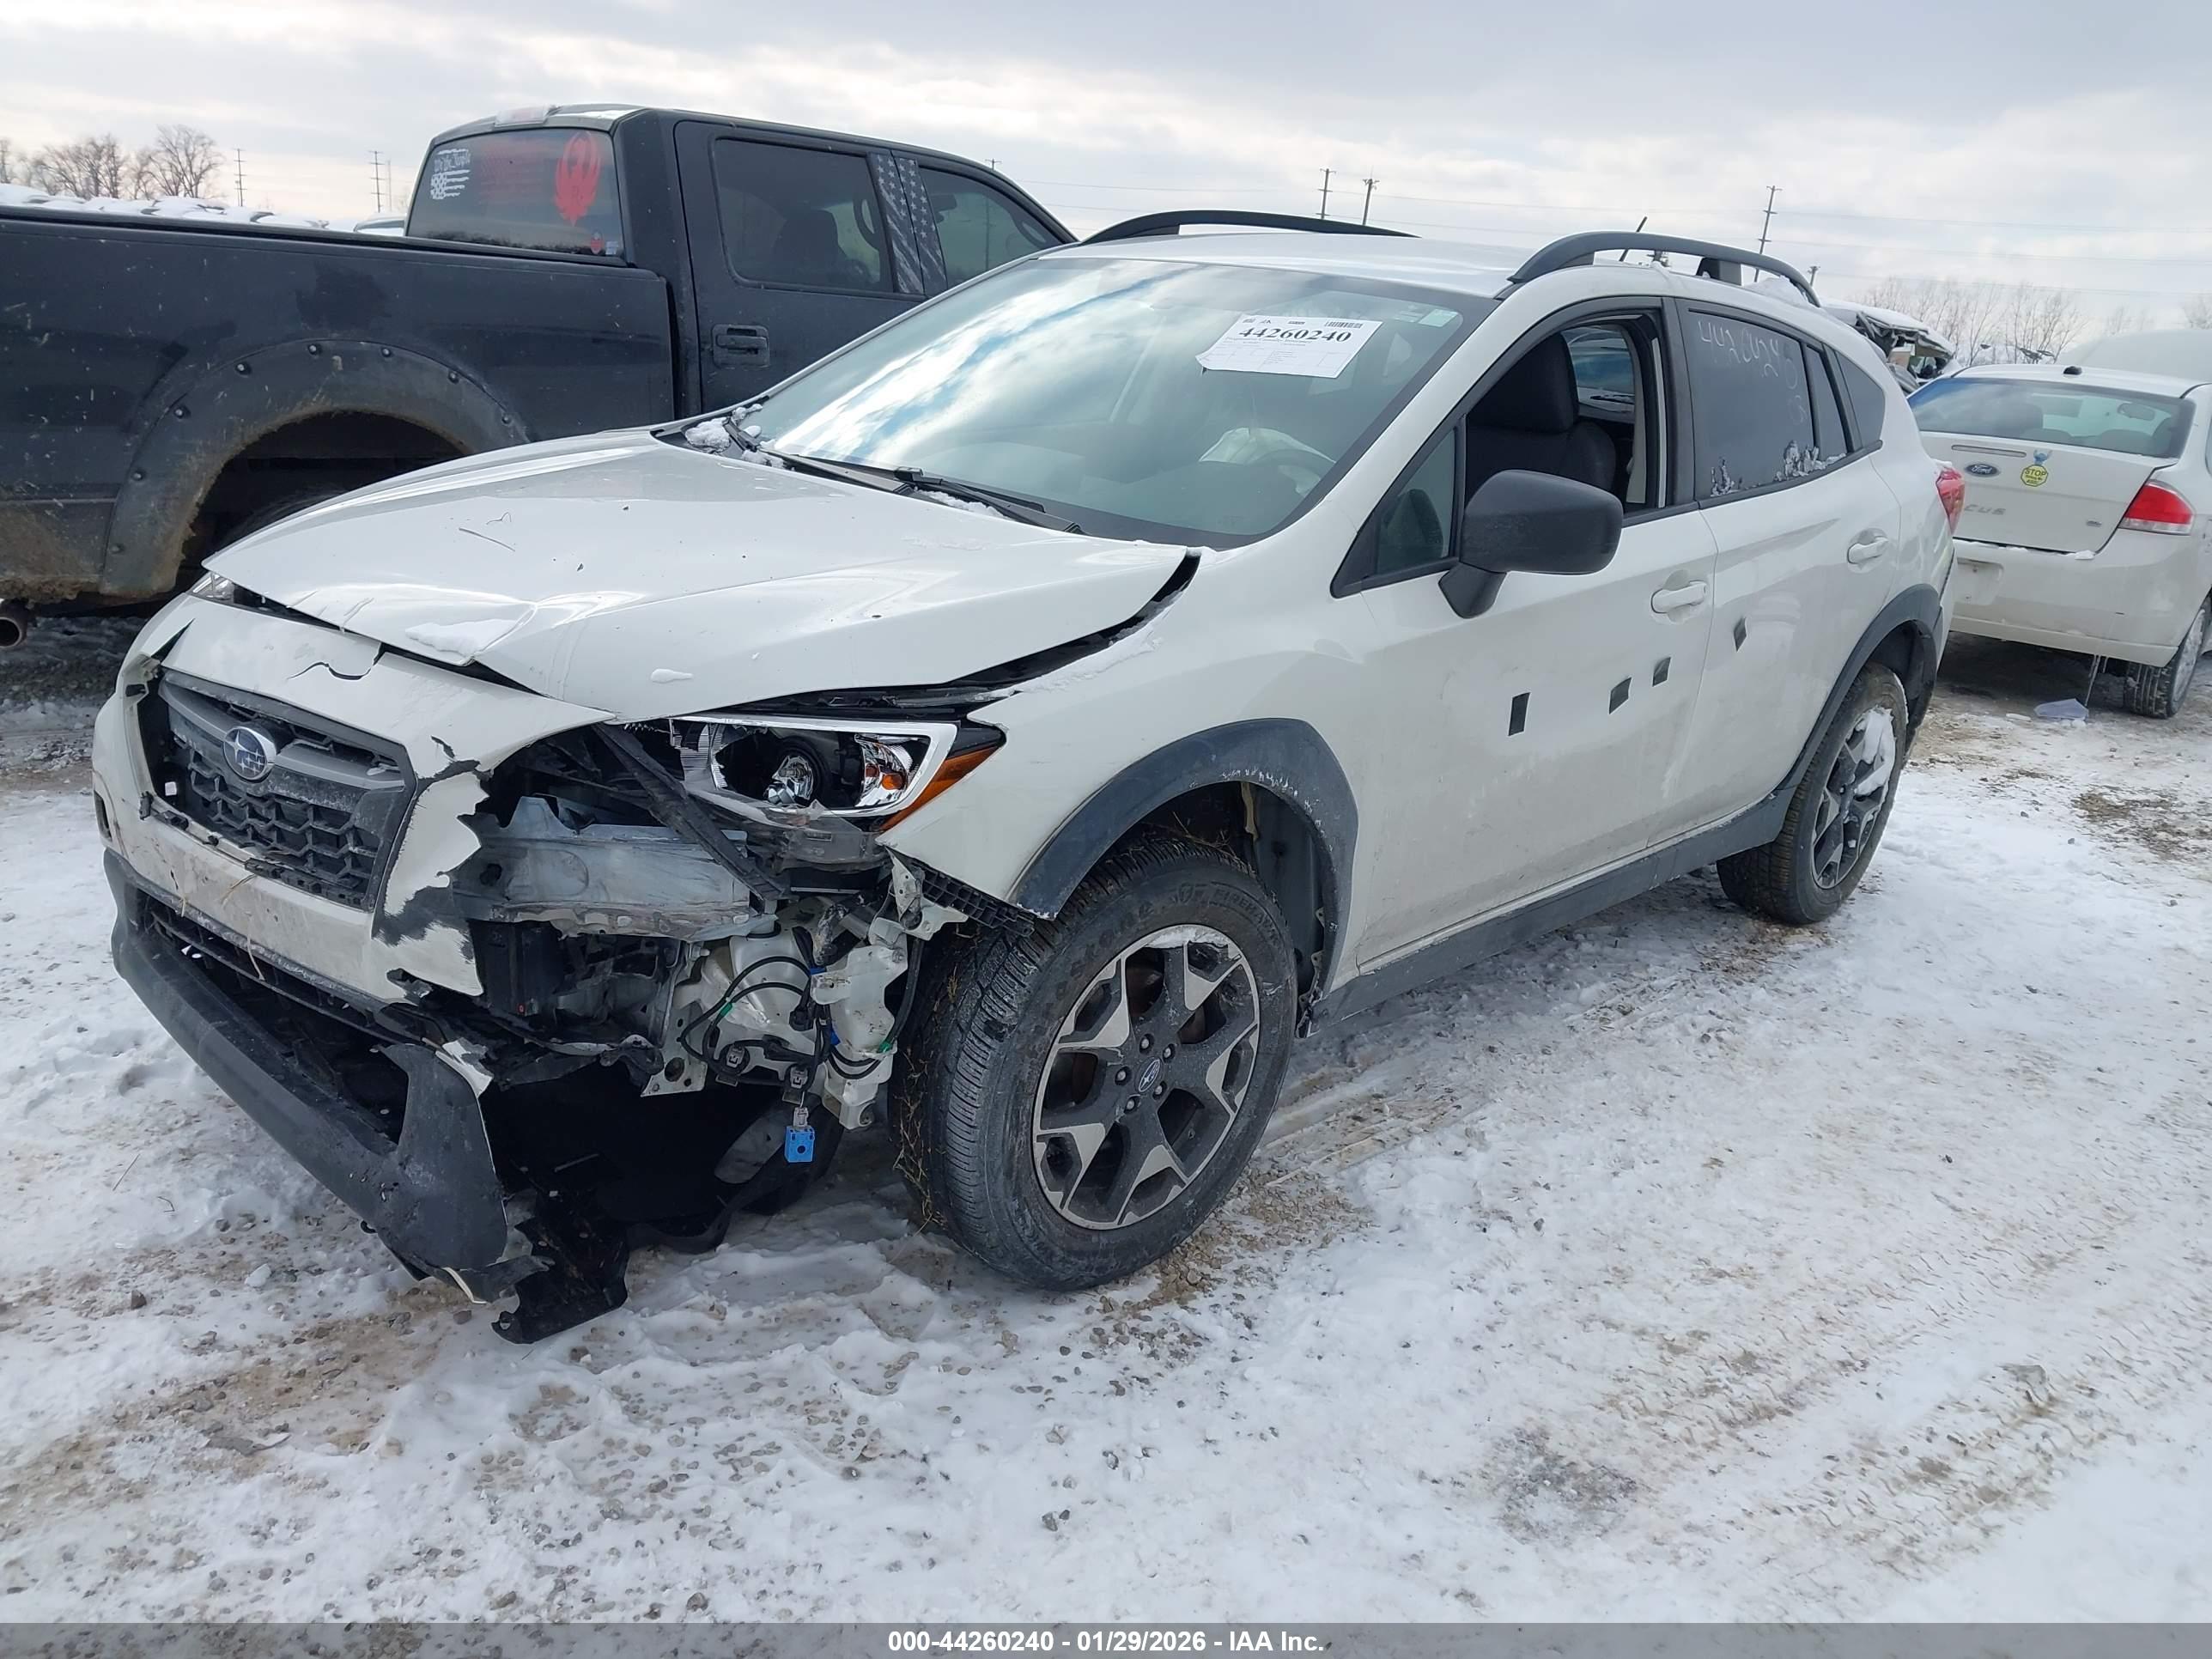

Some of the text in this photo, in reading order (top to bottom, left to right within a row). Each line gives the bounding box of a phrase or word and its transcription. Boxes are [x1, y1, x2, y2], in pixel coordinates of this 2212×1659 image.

[1238, 326, 1352, 343] 44260240
[2025, 468, 2047, 477] STOP
[1965, 504, 2006, 515] CUS
